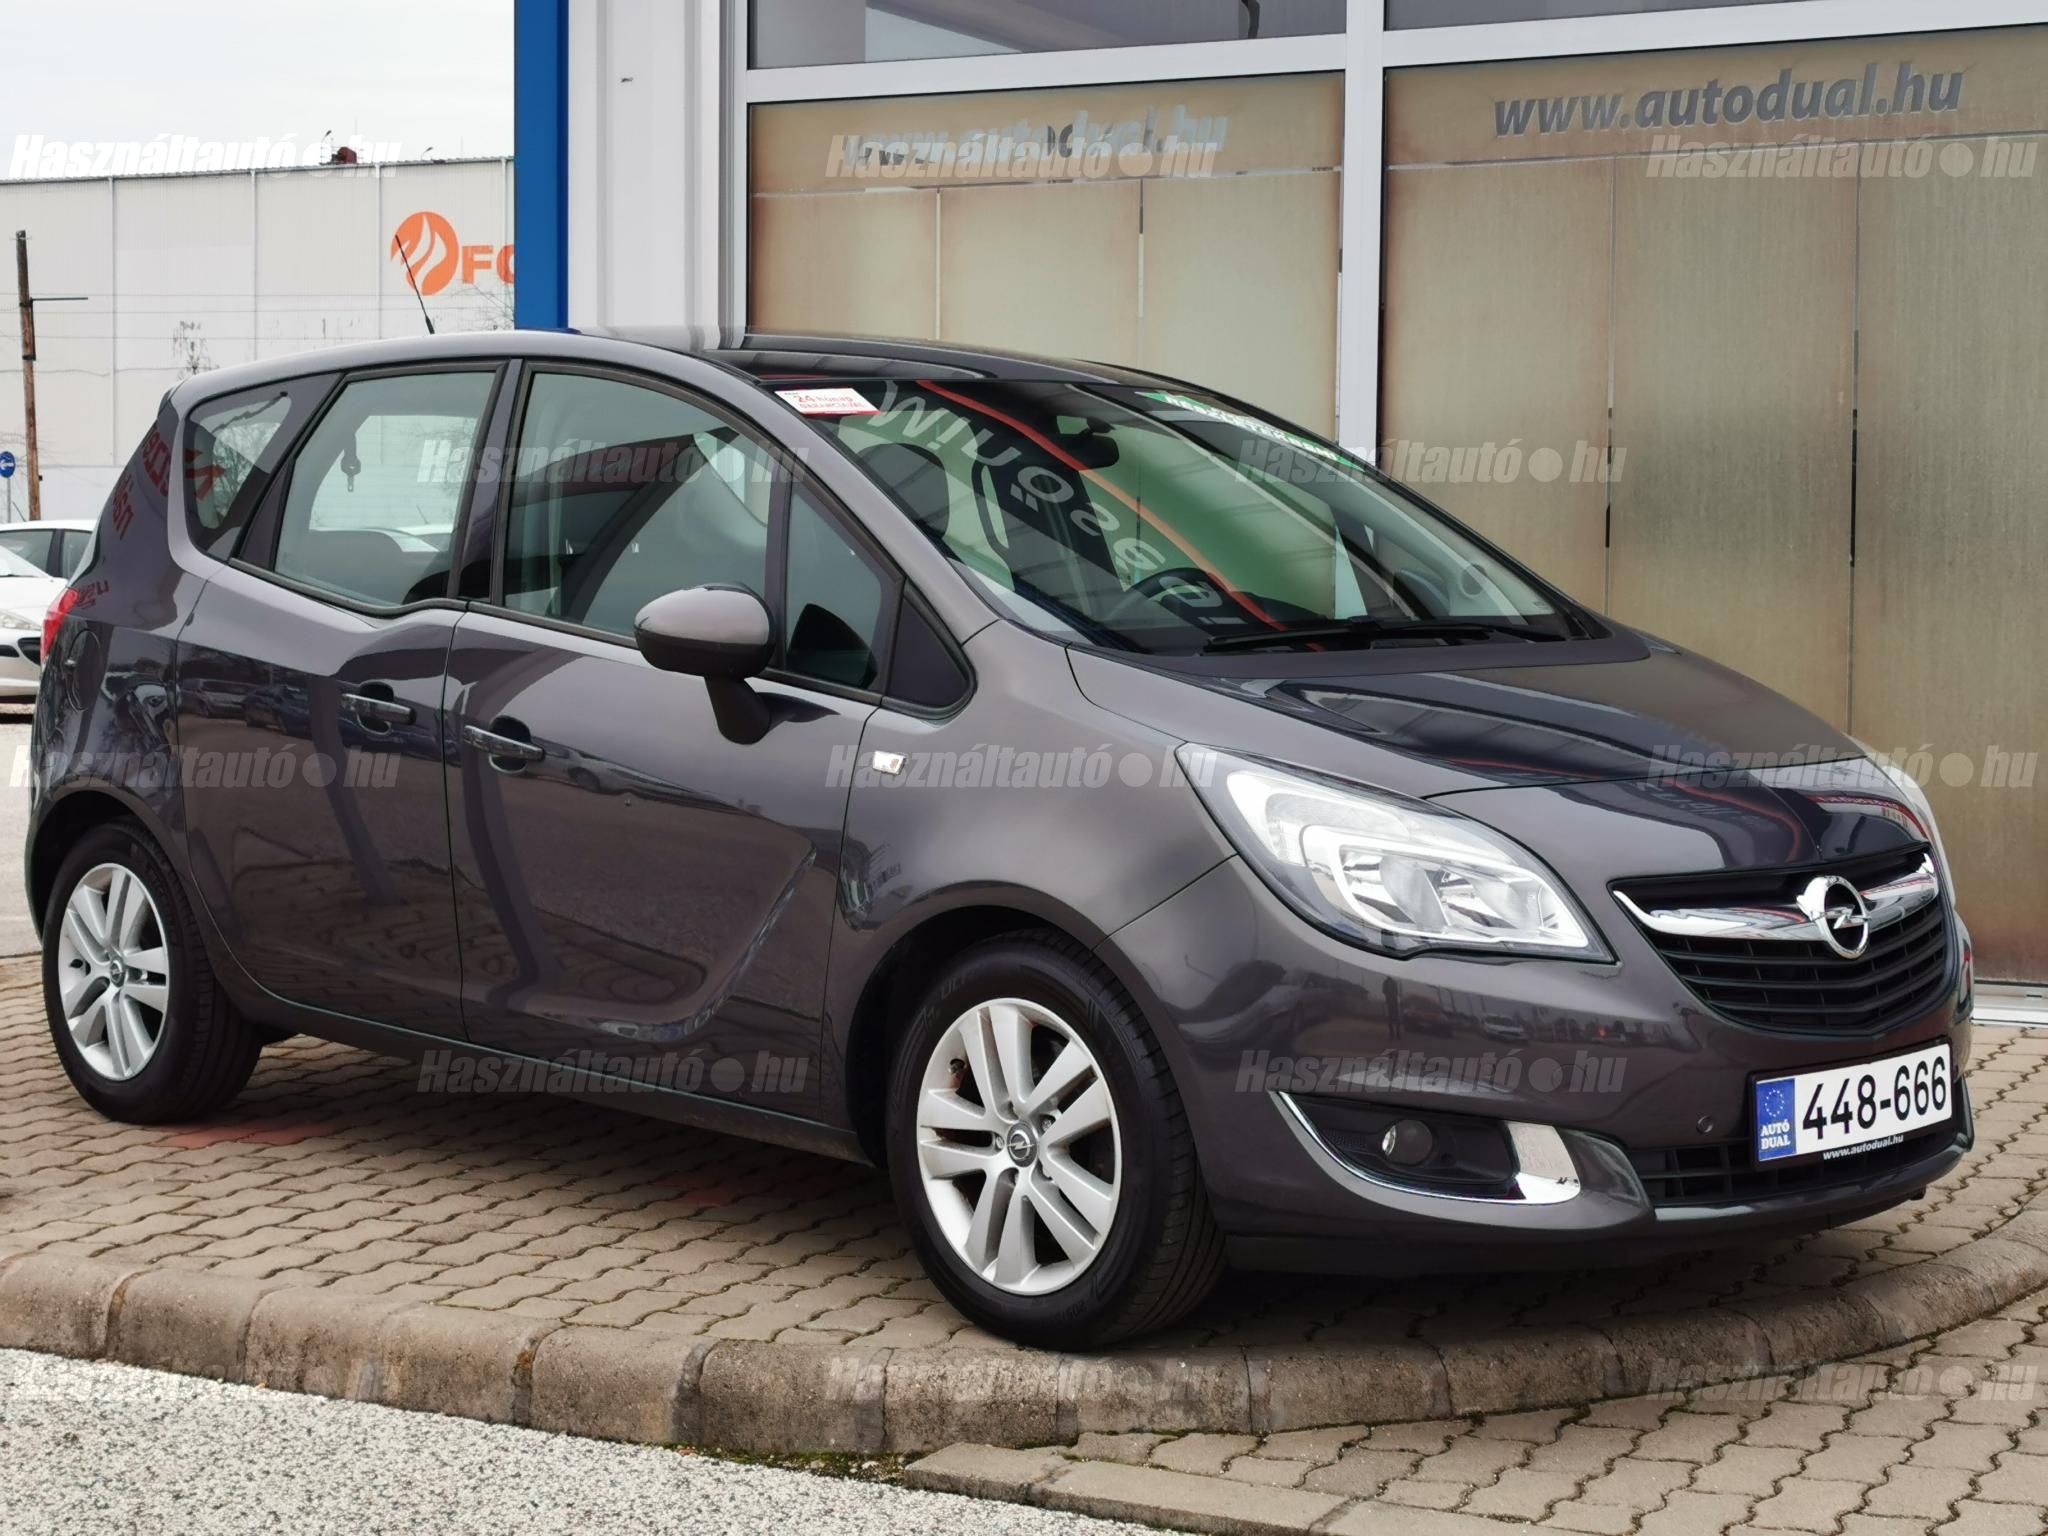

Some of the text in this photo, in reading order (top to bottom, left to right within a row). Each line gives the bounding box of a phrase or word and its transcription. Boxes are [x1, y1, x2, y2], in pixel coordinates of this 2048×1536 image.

[1494, 62, 1967, 138] www.autodual.hu
[1802, 1056, 1947, 1140] 448-666
[1760, 1119, 1791, 1137] AUTÓ
[1760, 1134, 1791, 1150] DUAL
[1822, 1135, 1905, 1160] www.autodual.hu
